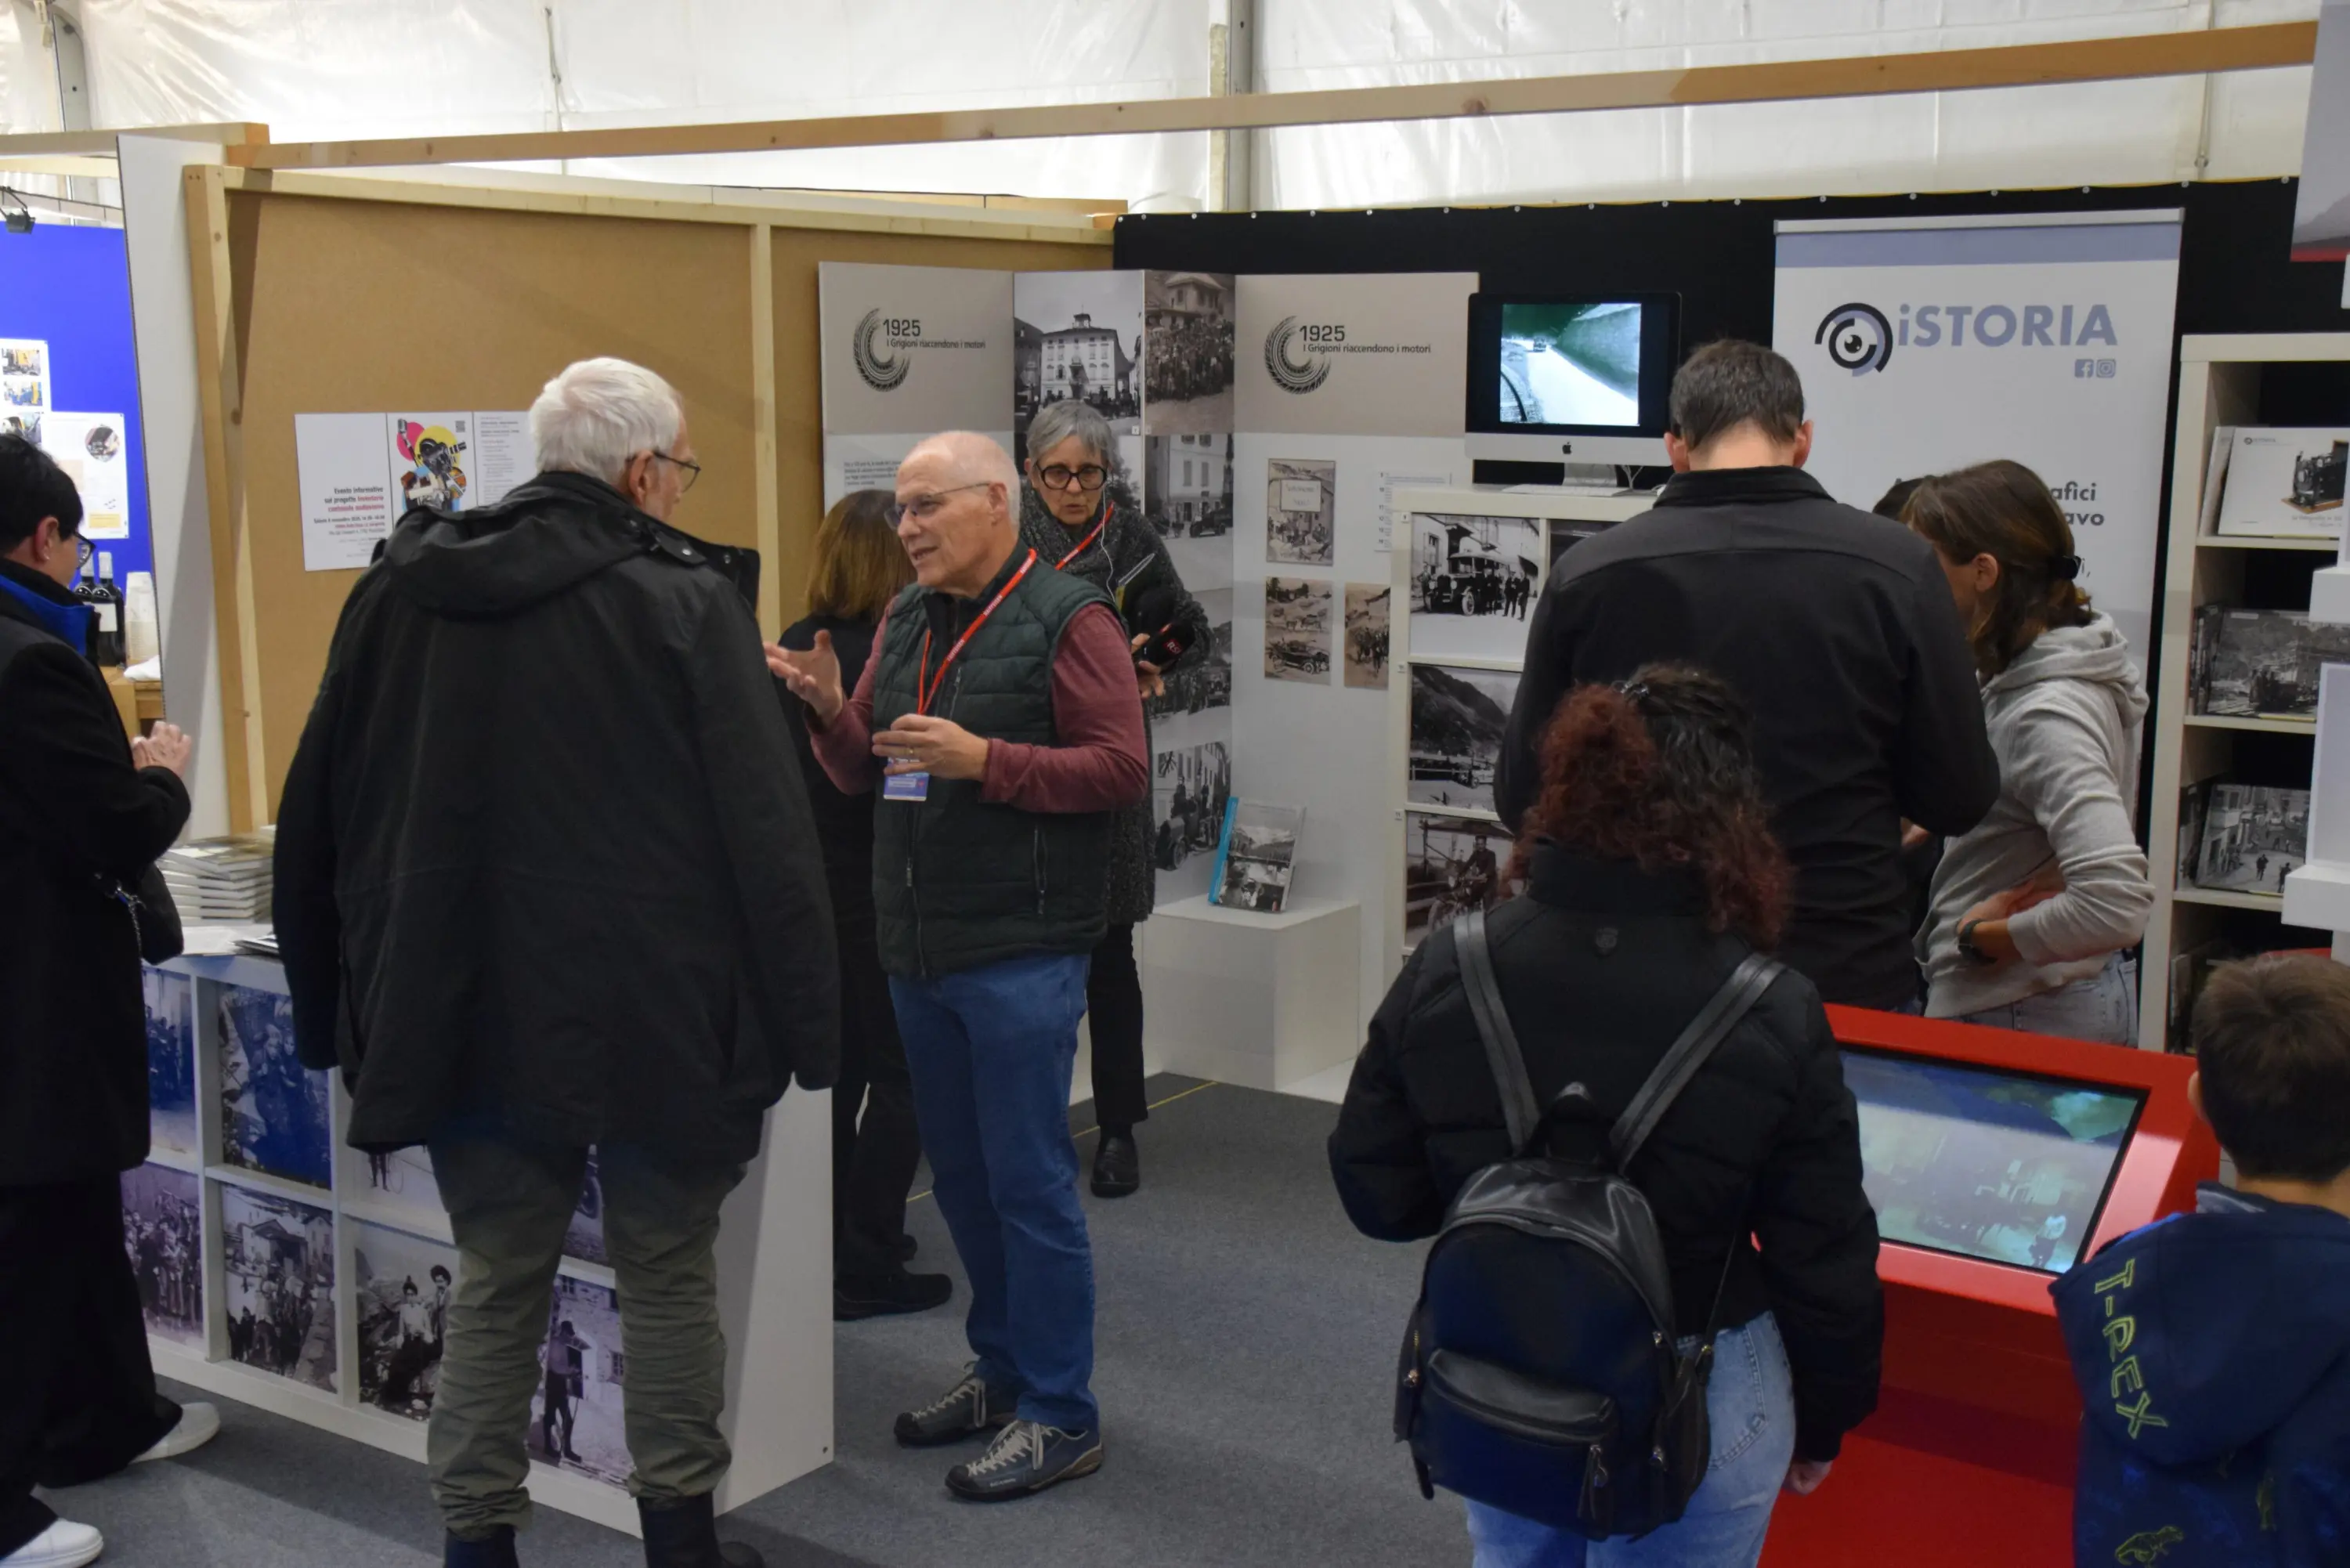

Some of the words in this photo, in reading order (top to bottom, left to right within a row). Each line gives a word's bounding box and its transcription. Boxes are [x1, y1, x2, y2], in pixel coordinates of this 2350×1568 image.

[883, 319, 921, 337] 1925
[1299, 325, 1346, 341] 1925
[1898, 303, 2118, 348] iSTORIA
[886, 338, 889, 347] I
[891, 338, 918, 350] Grigioni
[920, 338, 959, 349] riaccendono
[1307, 344, 1341, 355] Grigioni
[1343, 343, 1394, 353] riaccendono
[2050, 480, 2097, 501] afici
[2064, 513, 2105, 526] avo
[2081, 558, 2091, 578] i,
[2094, 1258, 2168, 1440] T-REX
